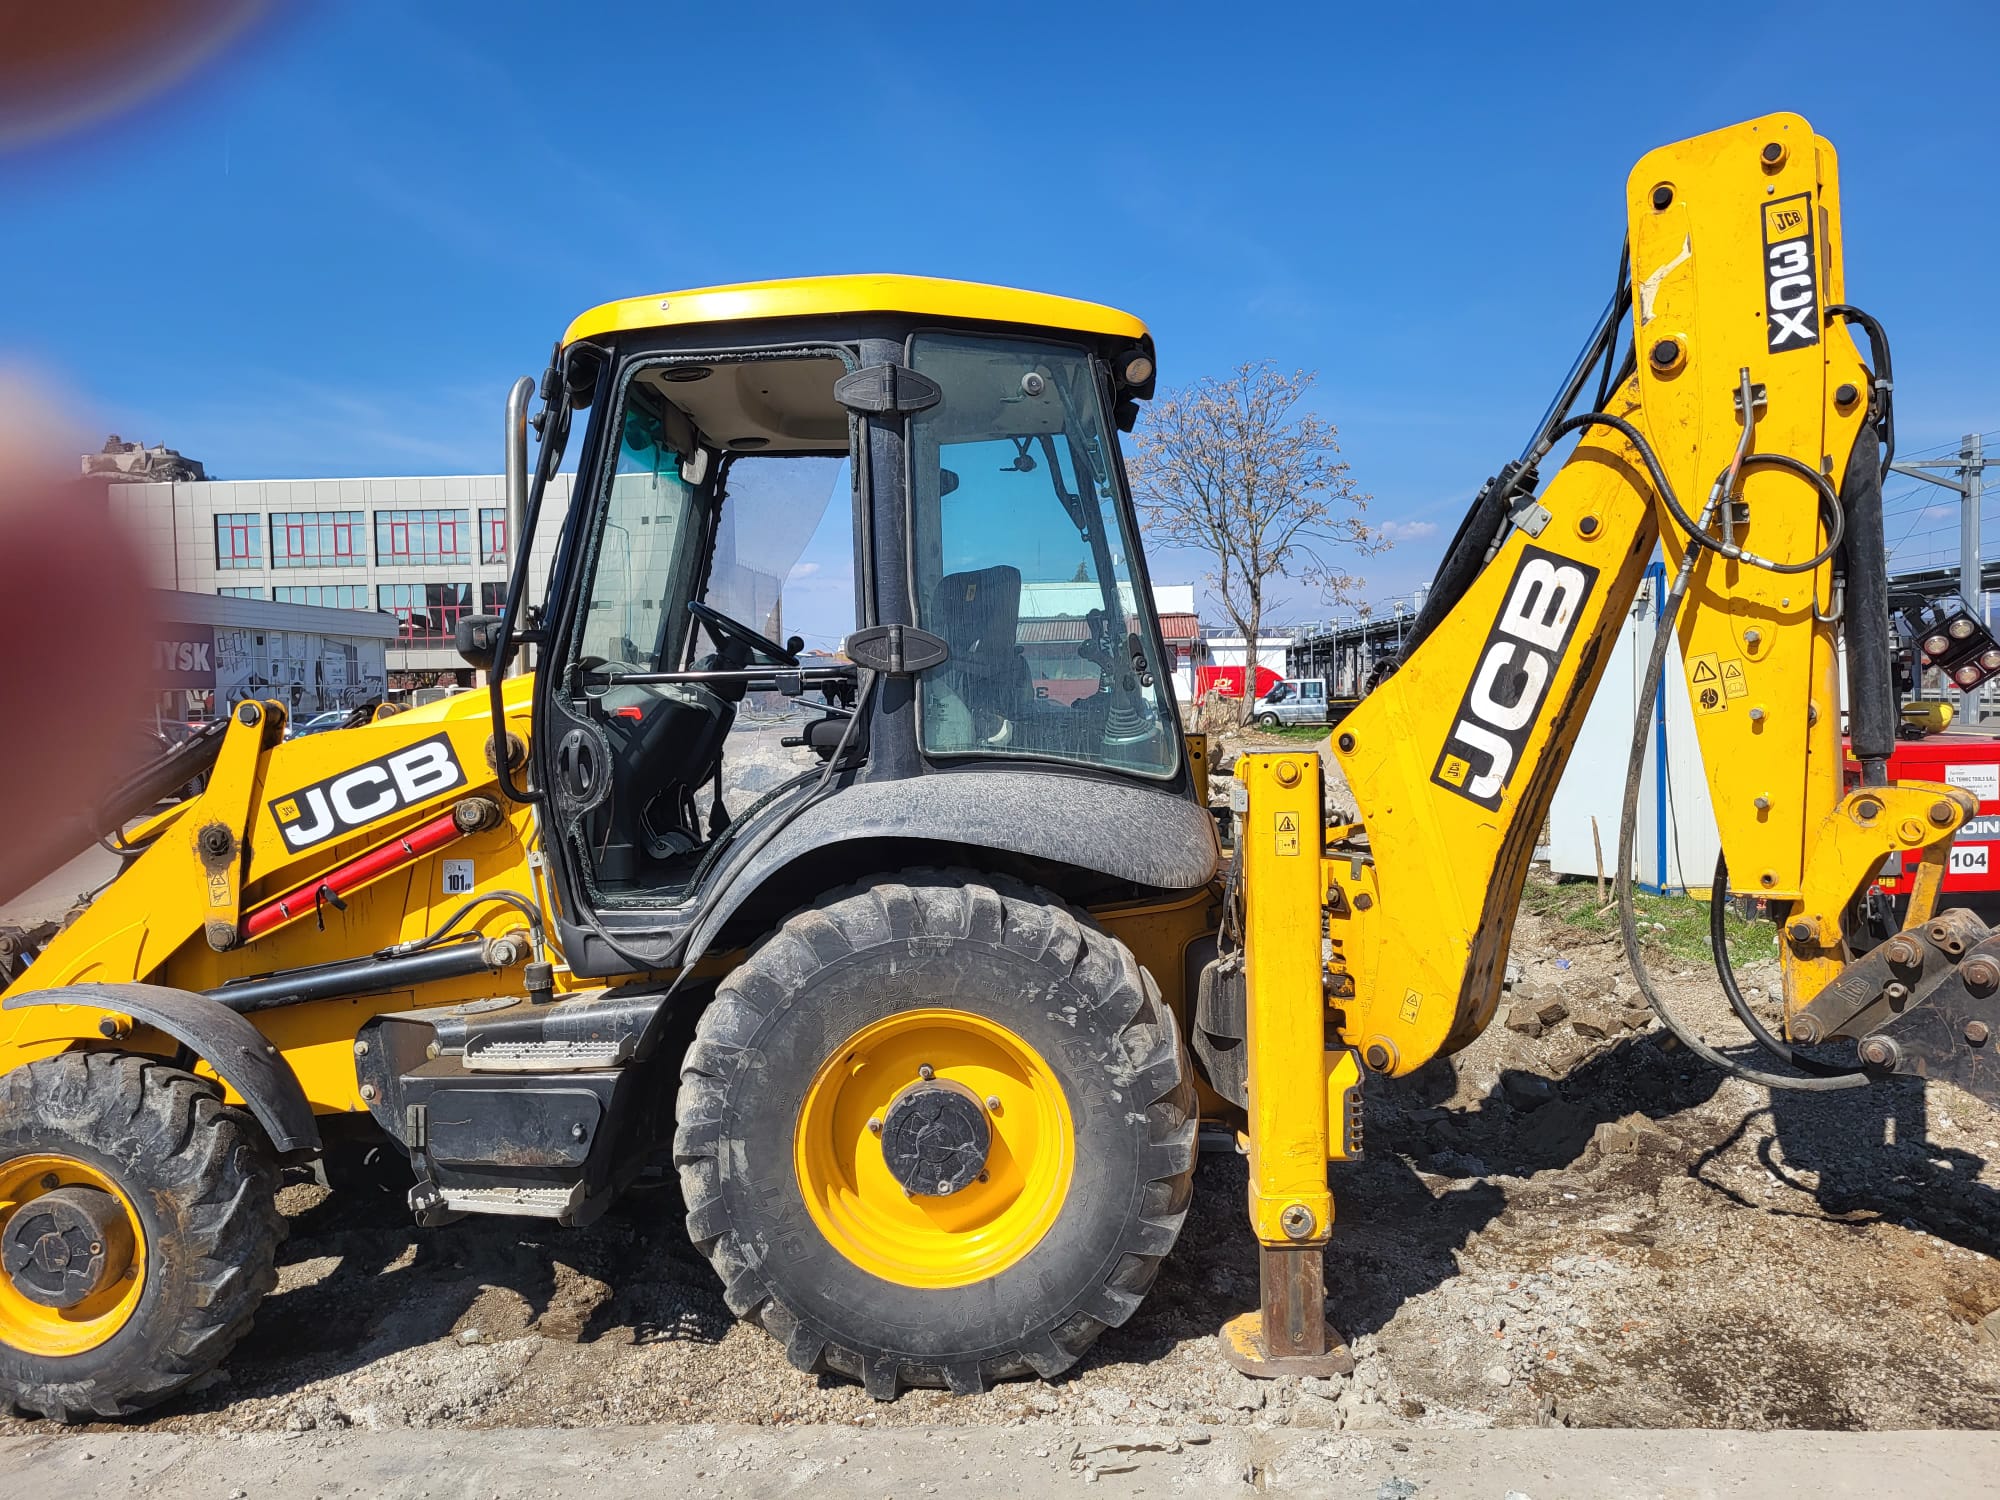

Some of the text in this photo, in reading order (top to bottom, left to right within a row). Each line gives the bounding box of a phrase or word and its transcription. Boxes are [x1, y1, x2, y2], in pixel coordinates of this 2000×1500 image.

[1776, 210, 1802, 231] JCB
[1769, 240, 1817, 346] 3CX
[1454, 558, 1585, 799] JCB
[1447, 762, 1460, 777] JCB
[285, 741, 459, 846] JCB
[1956, 821, 1999, 835] OIN
[1951, 852, 1986, 868] 104
